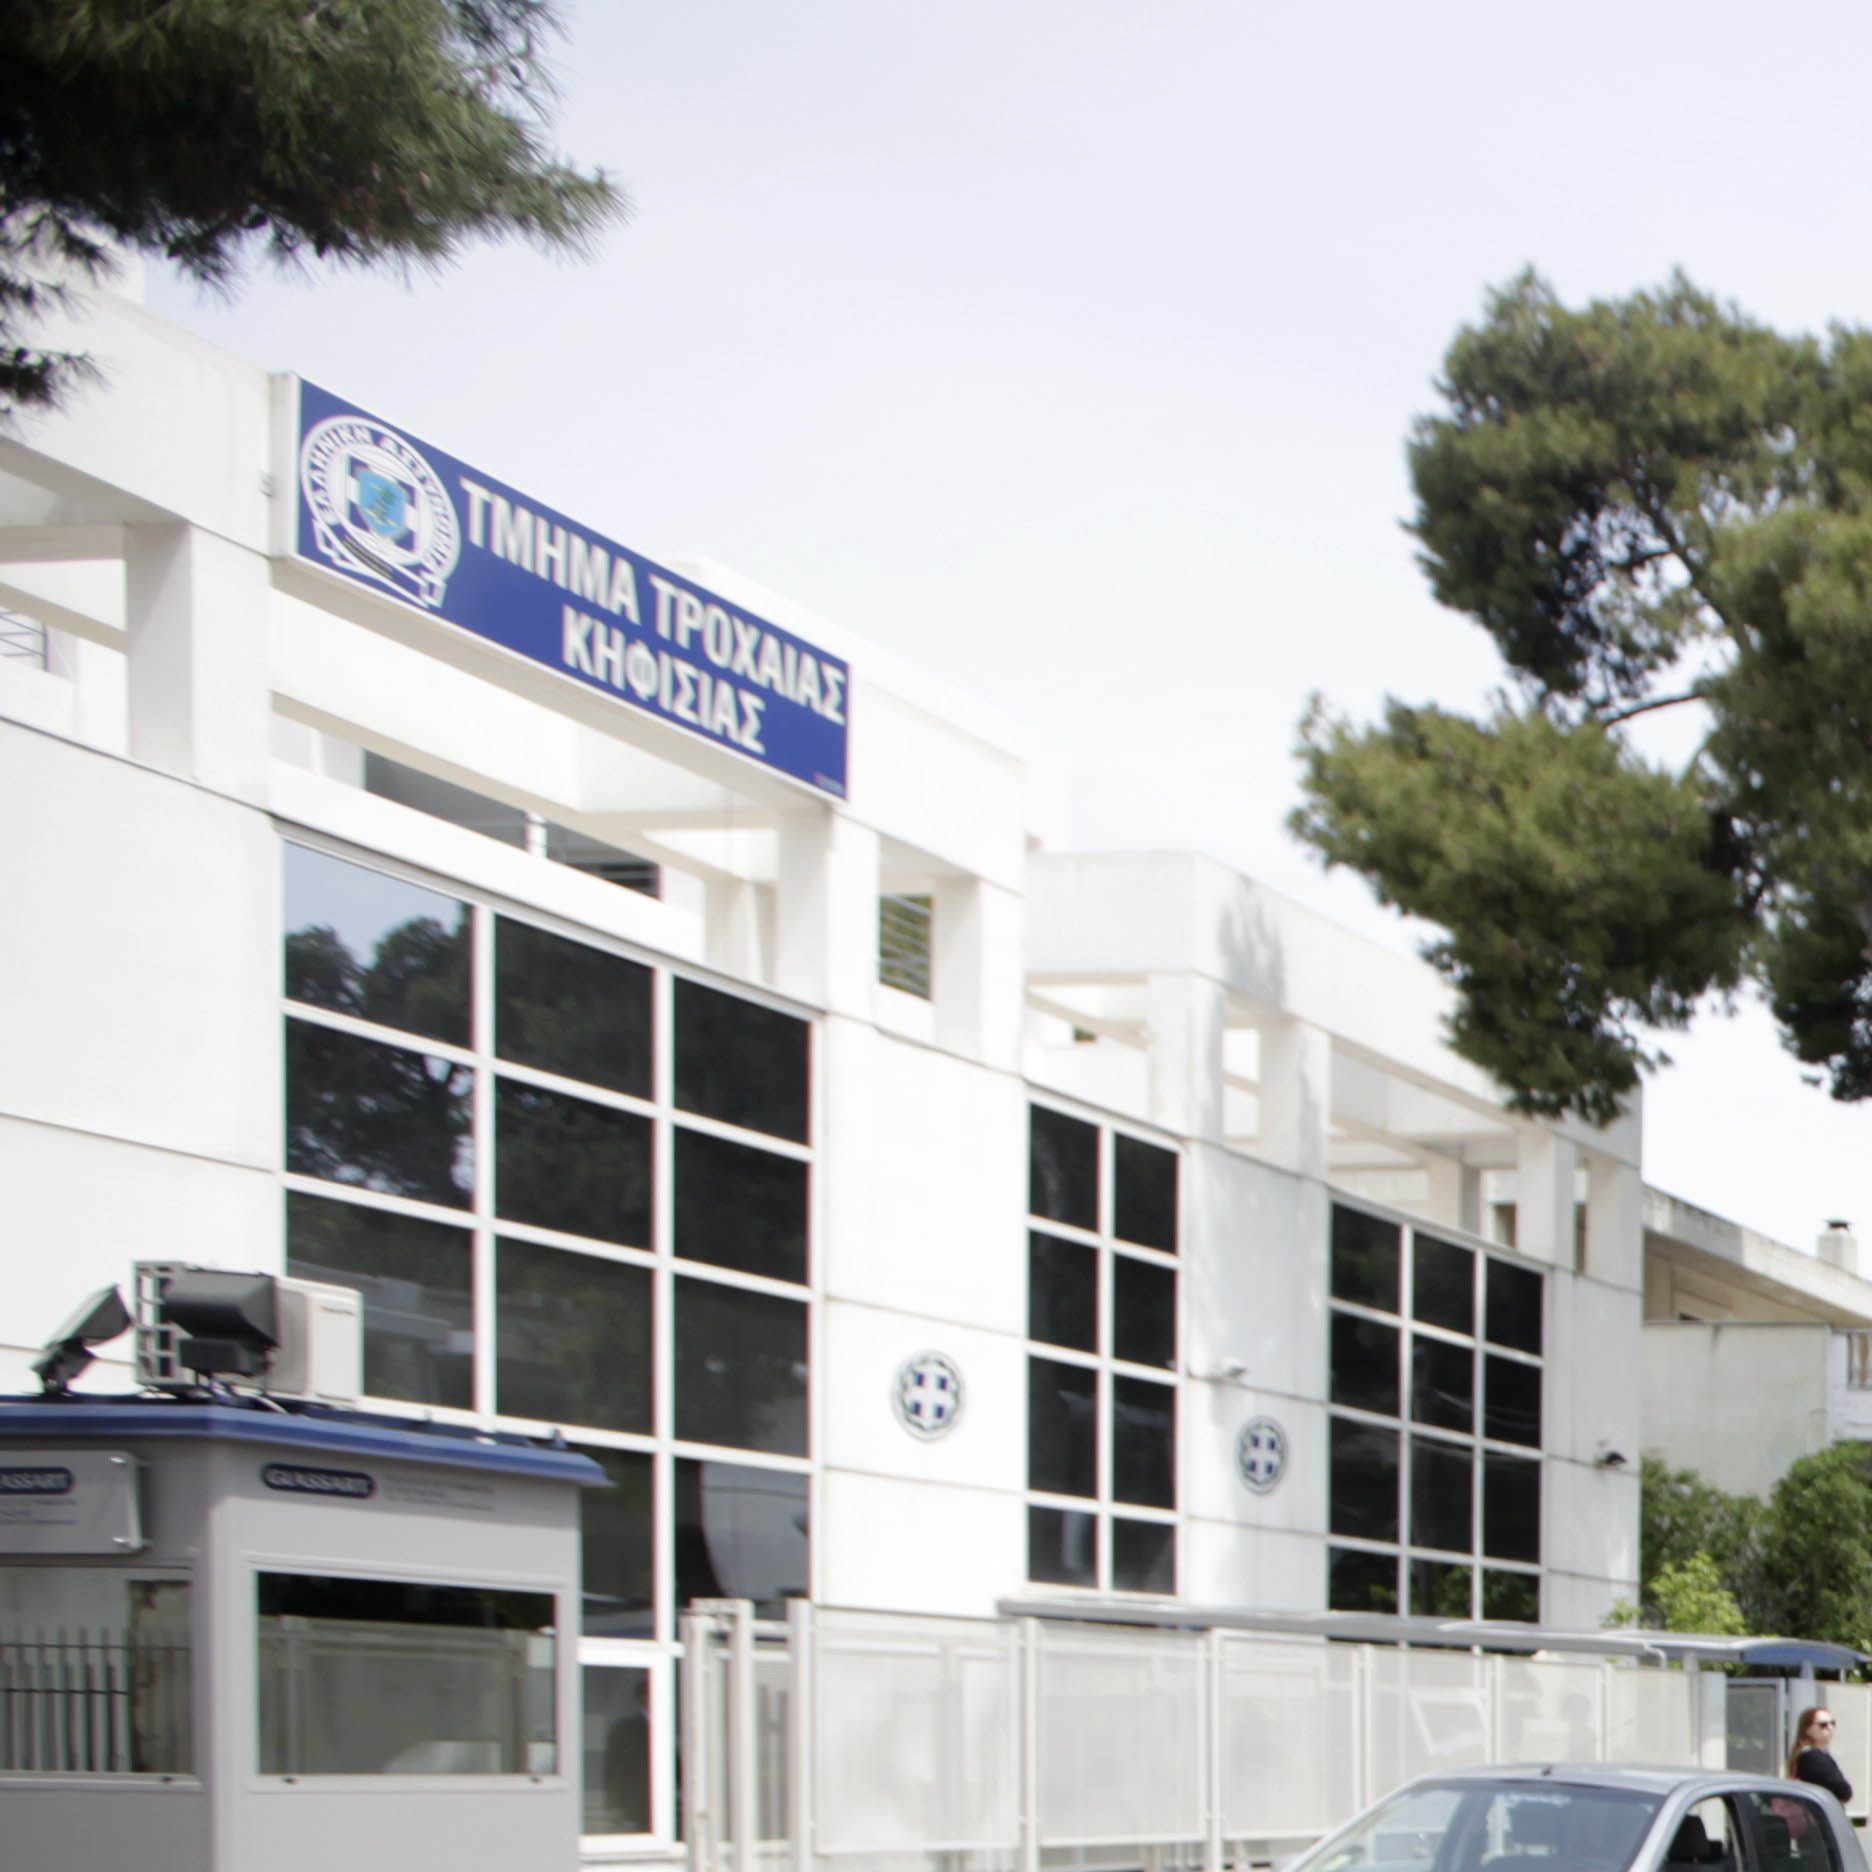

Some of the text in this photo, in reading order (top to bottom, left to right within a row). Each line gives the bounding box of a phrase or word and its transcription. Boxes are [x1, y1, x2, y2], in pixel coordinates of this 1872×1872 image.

[459, 475, 847, 727] ΤΜΗΜΑ ΤΡΟΧΑΙΑΣ
[561, 605, 766, 756] ΚΗΦΙΣΙΑΣ
